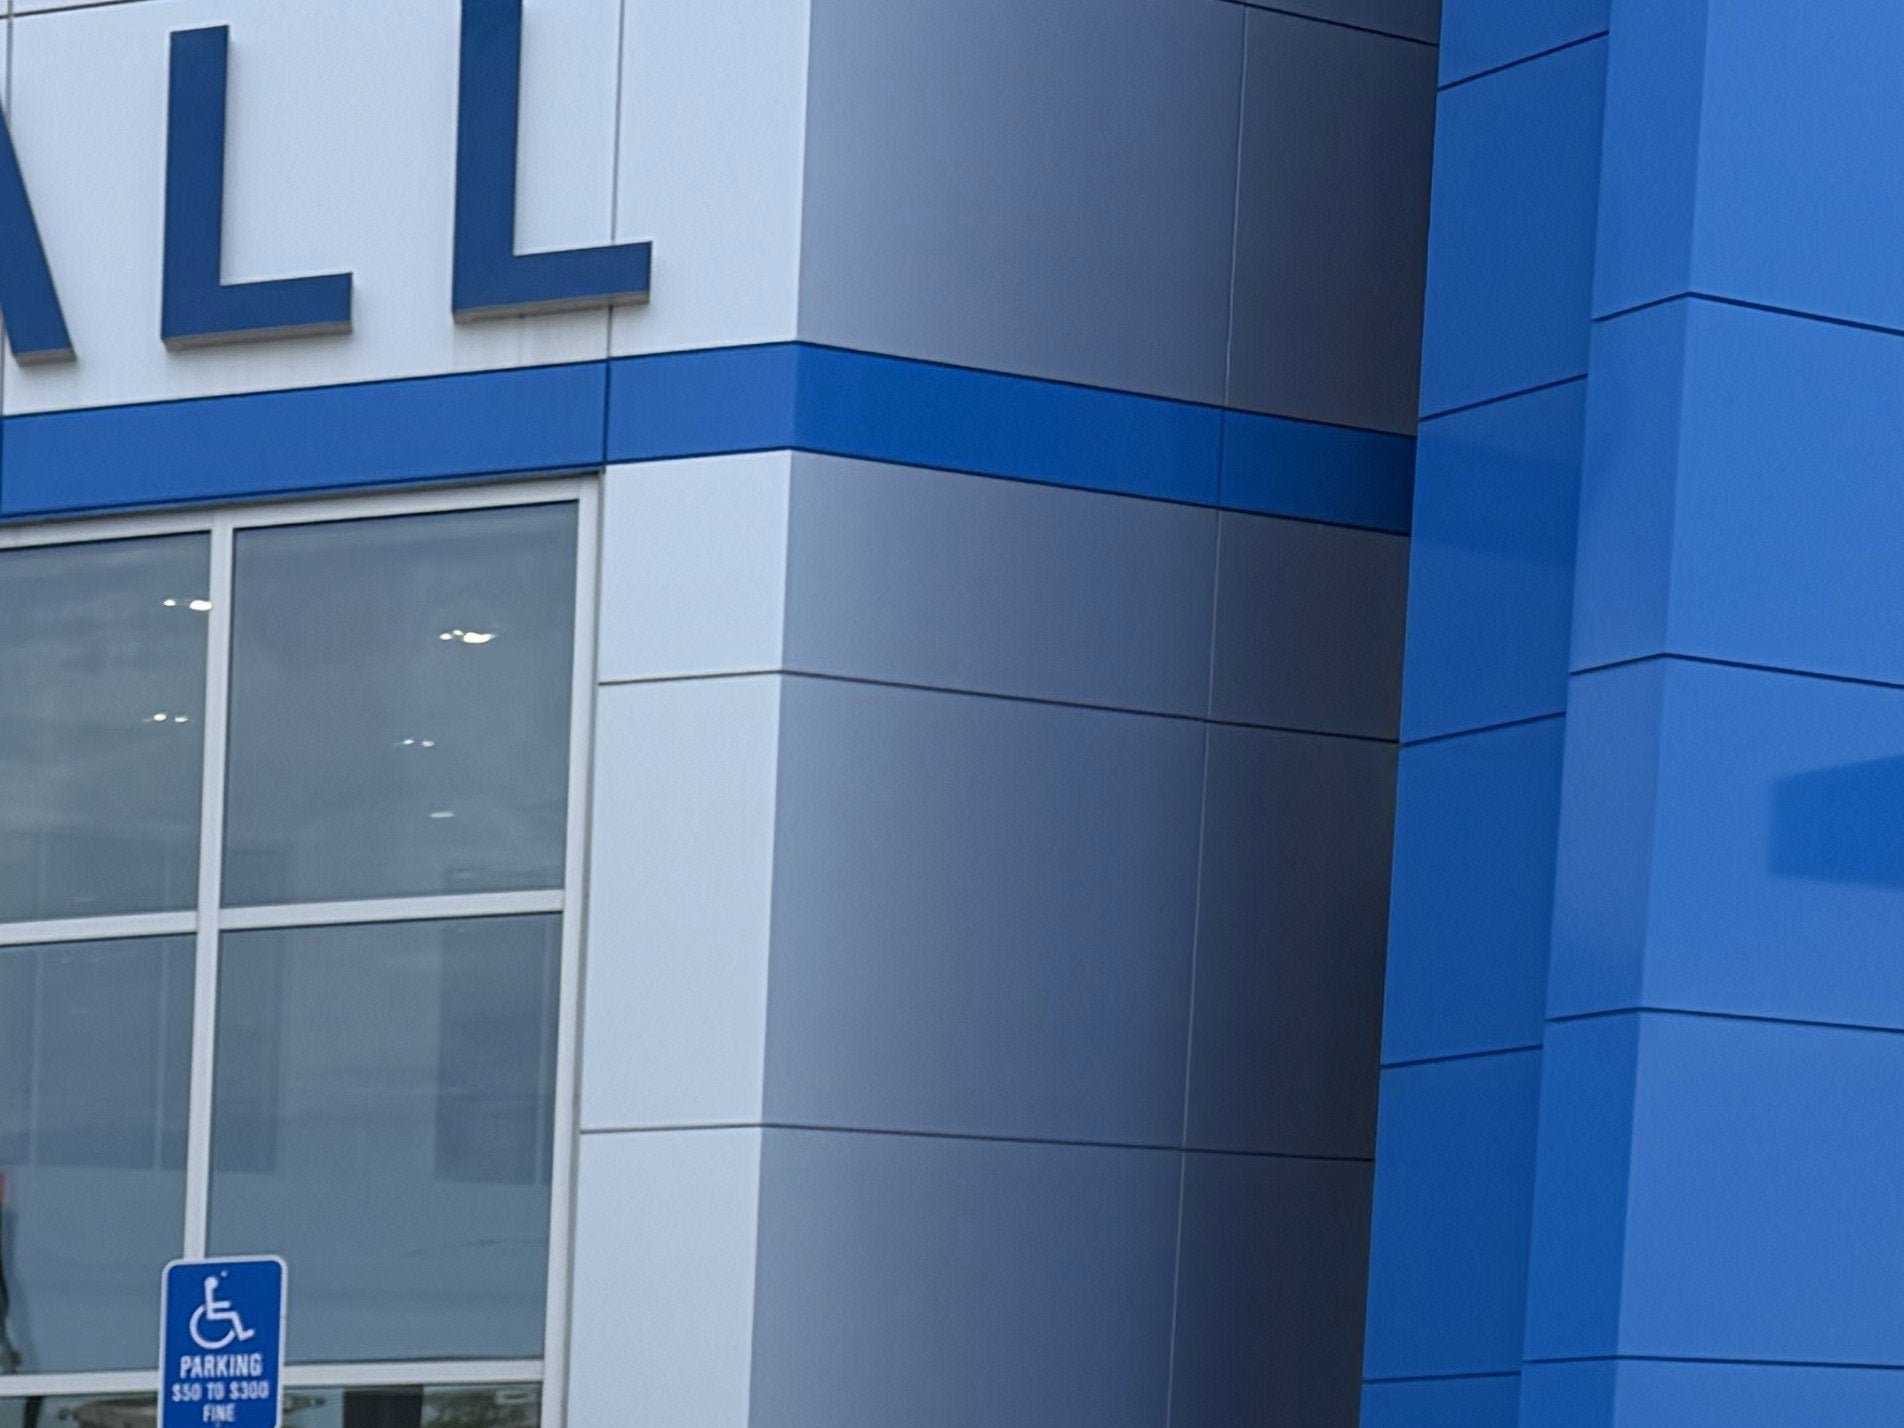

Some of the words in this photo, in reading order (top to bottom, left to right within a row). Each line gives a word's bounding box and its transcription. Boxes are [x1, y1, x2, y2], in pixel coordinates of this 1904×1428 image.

[180, 1353, 263, 1378] PARKING
[172, 1383, 201, 1401] $50
[207, 1383, 225, 1400] TO
[230, 1381, 269, 1400] $300
[203, 1403, 236, 1422] FINE
